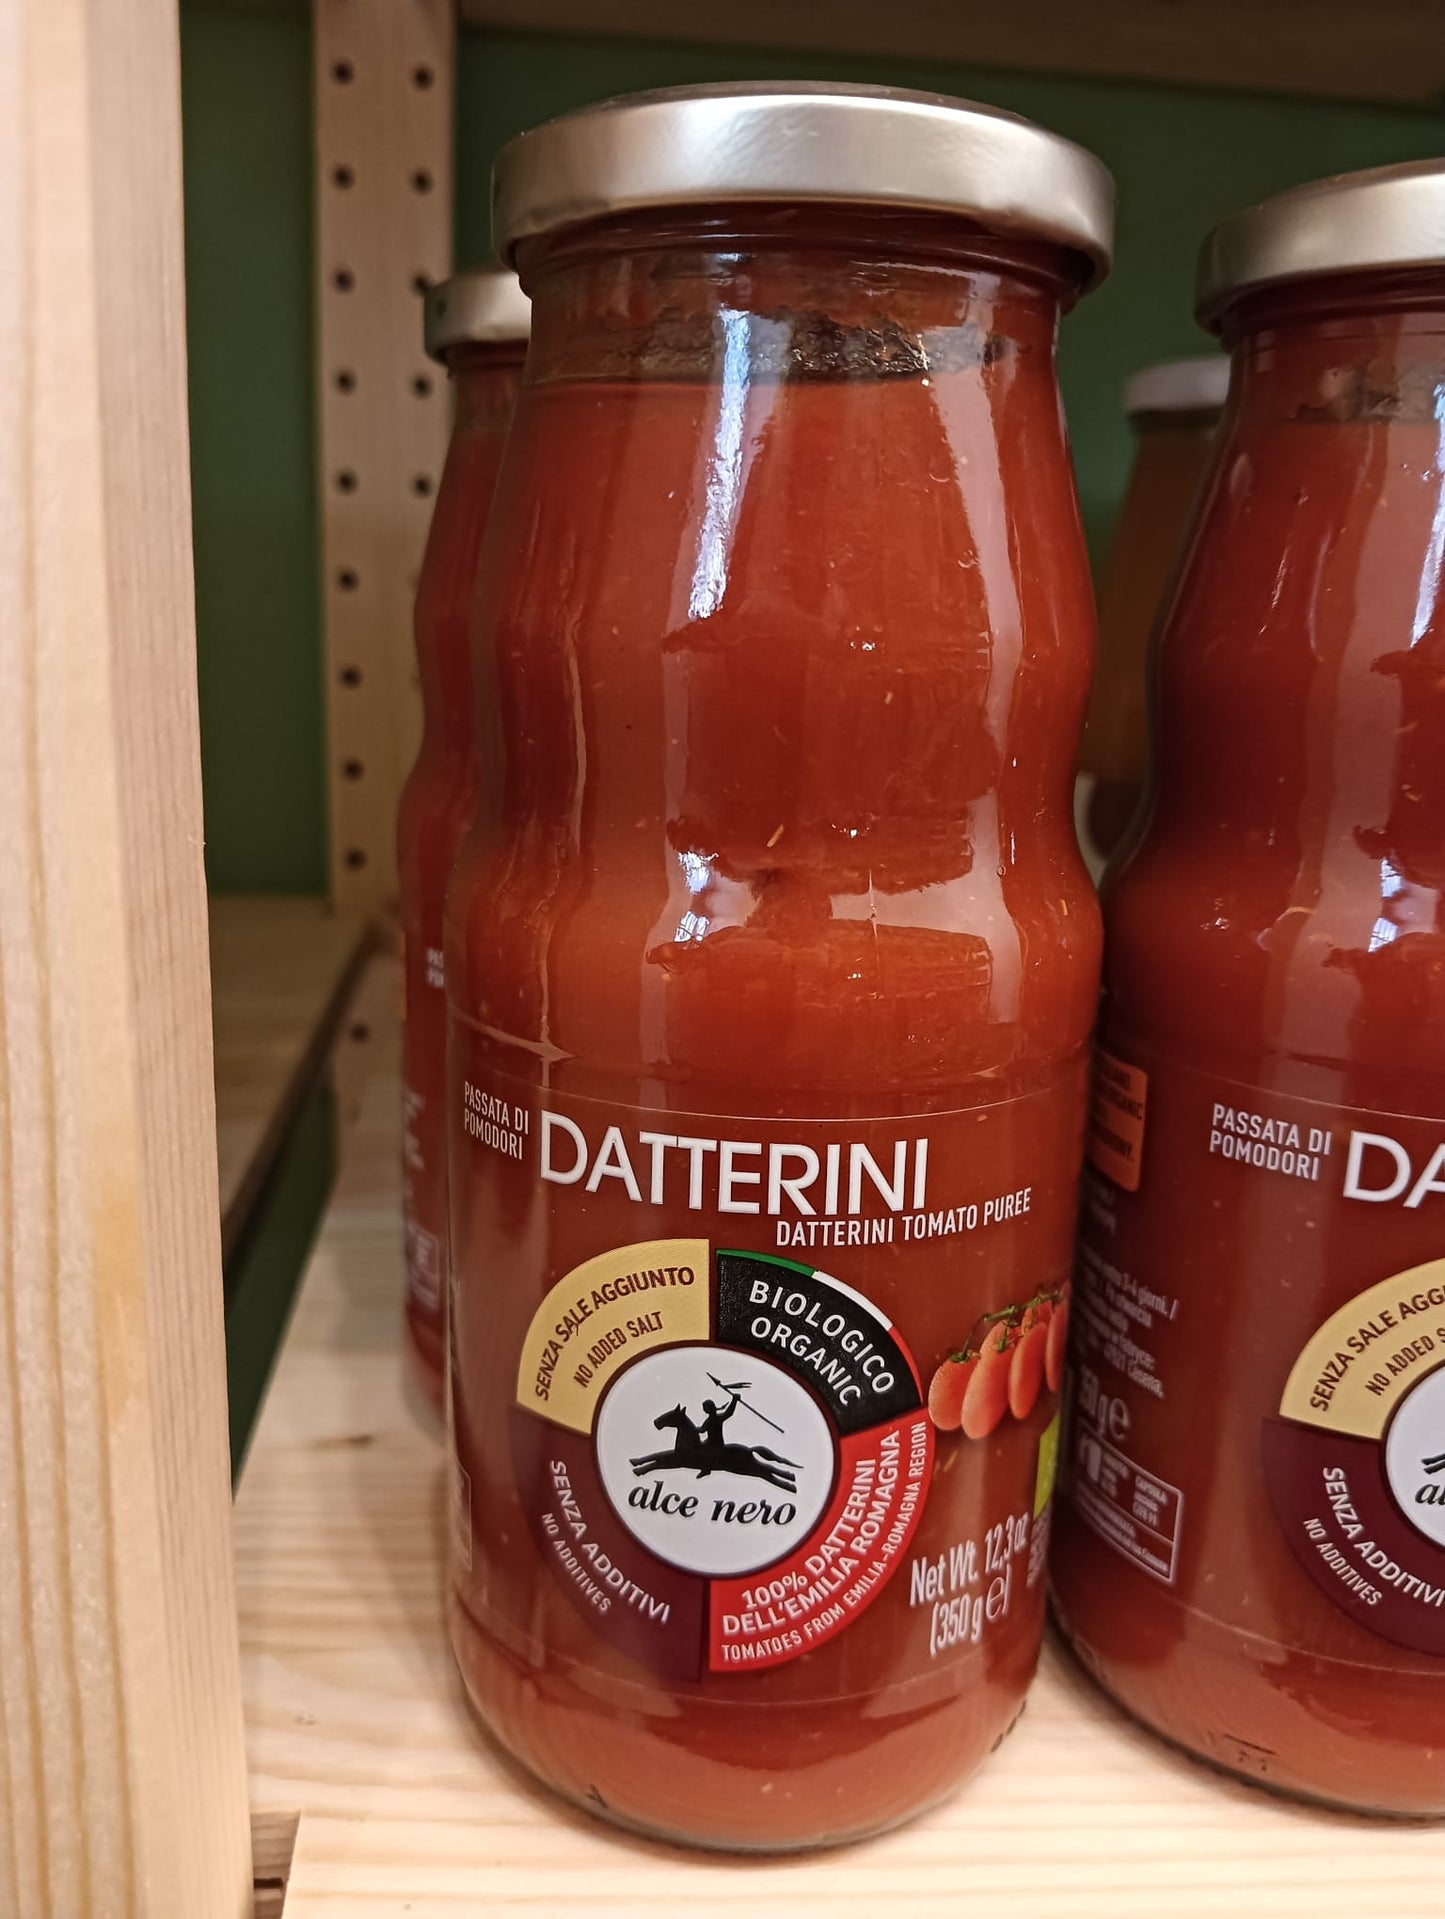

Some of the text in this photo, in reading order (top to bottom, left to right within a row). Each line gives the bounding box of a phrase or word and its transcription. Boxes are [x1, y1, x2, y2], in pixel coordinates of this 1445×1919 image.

[464, 1081, 510, 1127] PASSATA
[514, 1109, 529, 1135] DI
[464, 1108, 523, 1160] POMODORI
[1212, 1102, 1332, 1156] PASSATA DI
[541, 1109, 929, 1216] DATTERINI
[1209, 1130, 1320, 1181] POMODORI
[776, 1187, 1032, 1247] DATTERINI TOMATO PUREE
[535, 1266, 695, 1402] SENZA SALE AGGIUNTO
[573, 1311, 664, 1389] NO ADDED SALT
[749, 1279, 895, 1394] BIOLOGICO
[750, 1316, 862, 1406] ORGANIC
[1310, 1351, 1355, 1412] SENZA
[1346, 1310, 1399, 1354] SALE
[1365, 1372, 1391, 1397] NO
[1385, 1335, 1436, 1377] ADDED
[550, 1460, 671, 1625] SENZA ADDITIVI
[628, 1480, 797, 1526] alce nero
[722, 1430, 901, 1637] DELL'EMILIA ROMAGNA
[722, 1421, 927, 1664] TOMATOES FROM EMILIA-ROMAGNA REGION
[741, 1459, 877, 1610] 100% DATTERINI
[1323, 1467, 1445, 1608] SENZA ADDITIVI
[542, 1513, 612, 1615] NO ADDITIVES
[910, 1554, 946, 1608] Net
[950, 1539, 979, 1592] Wt.
[1303, 1518, 1384, 1606] NO ADDITIVES
